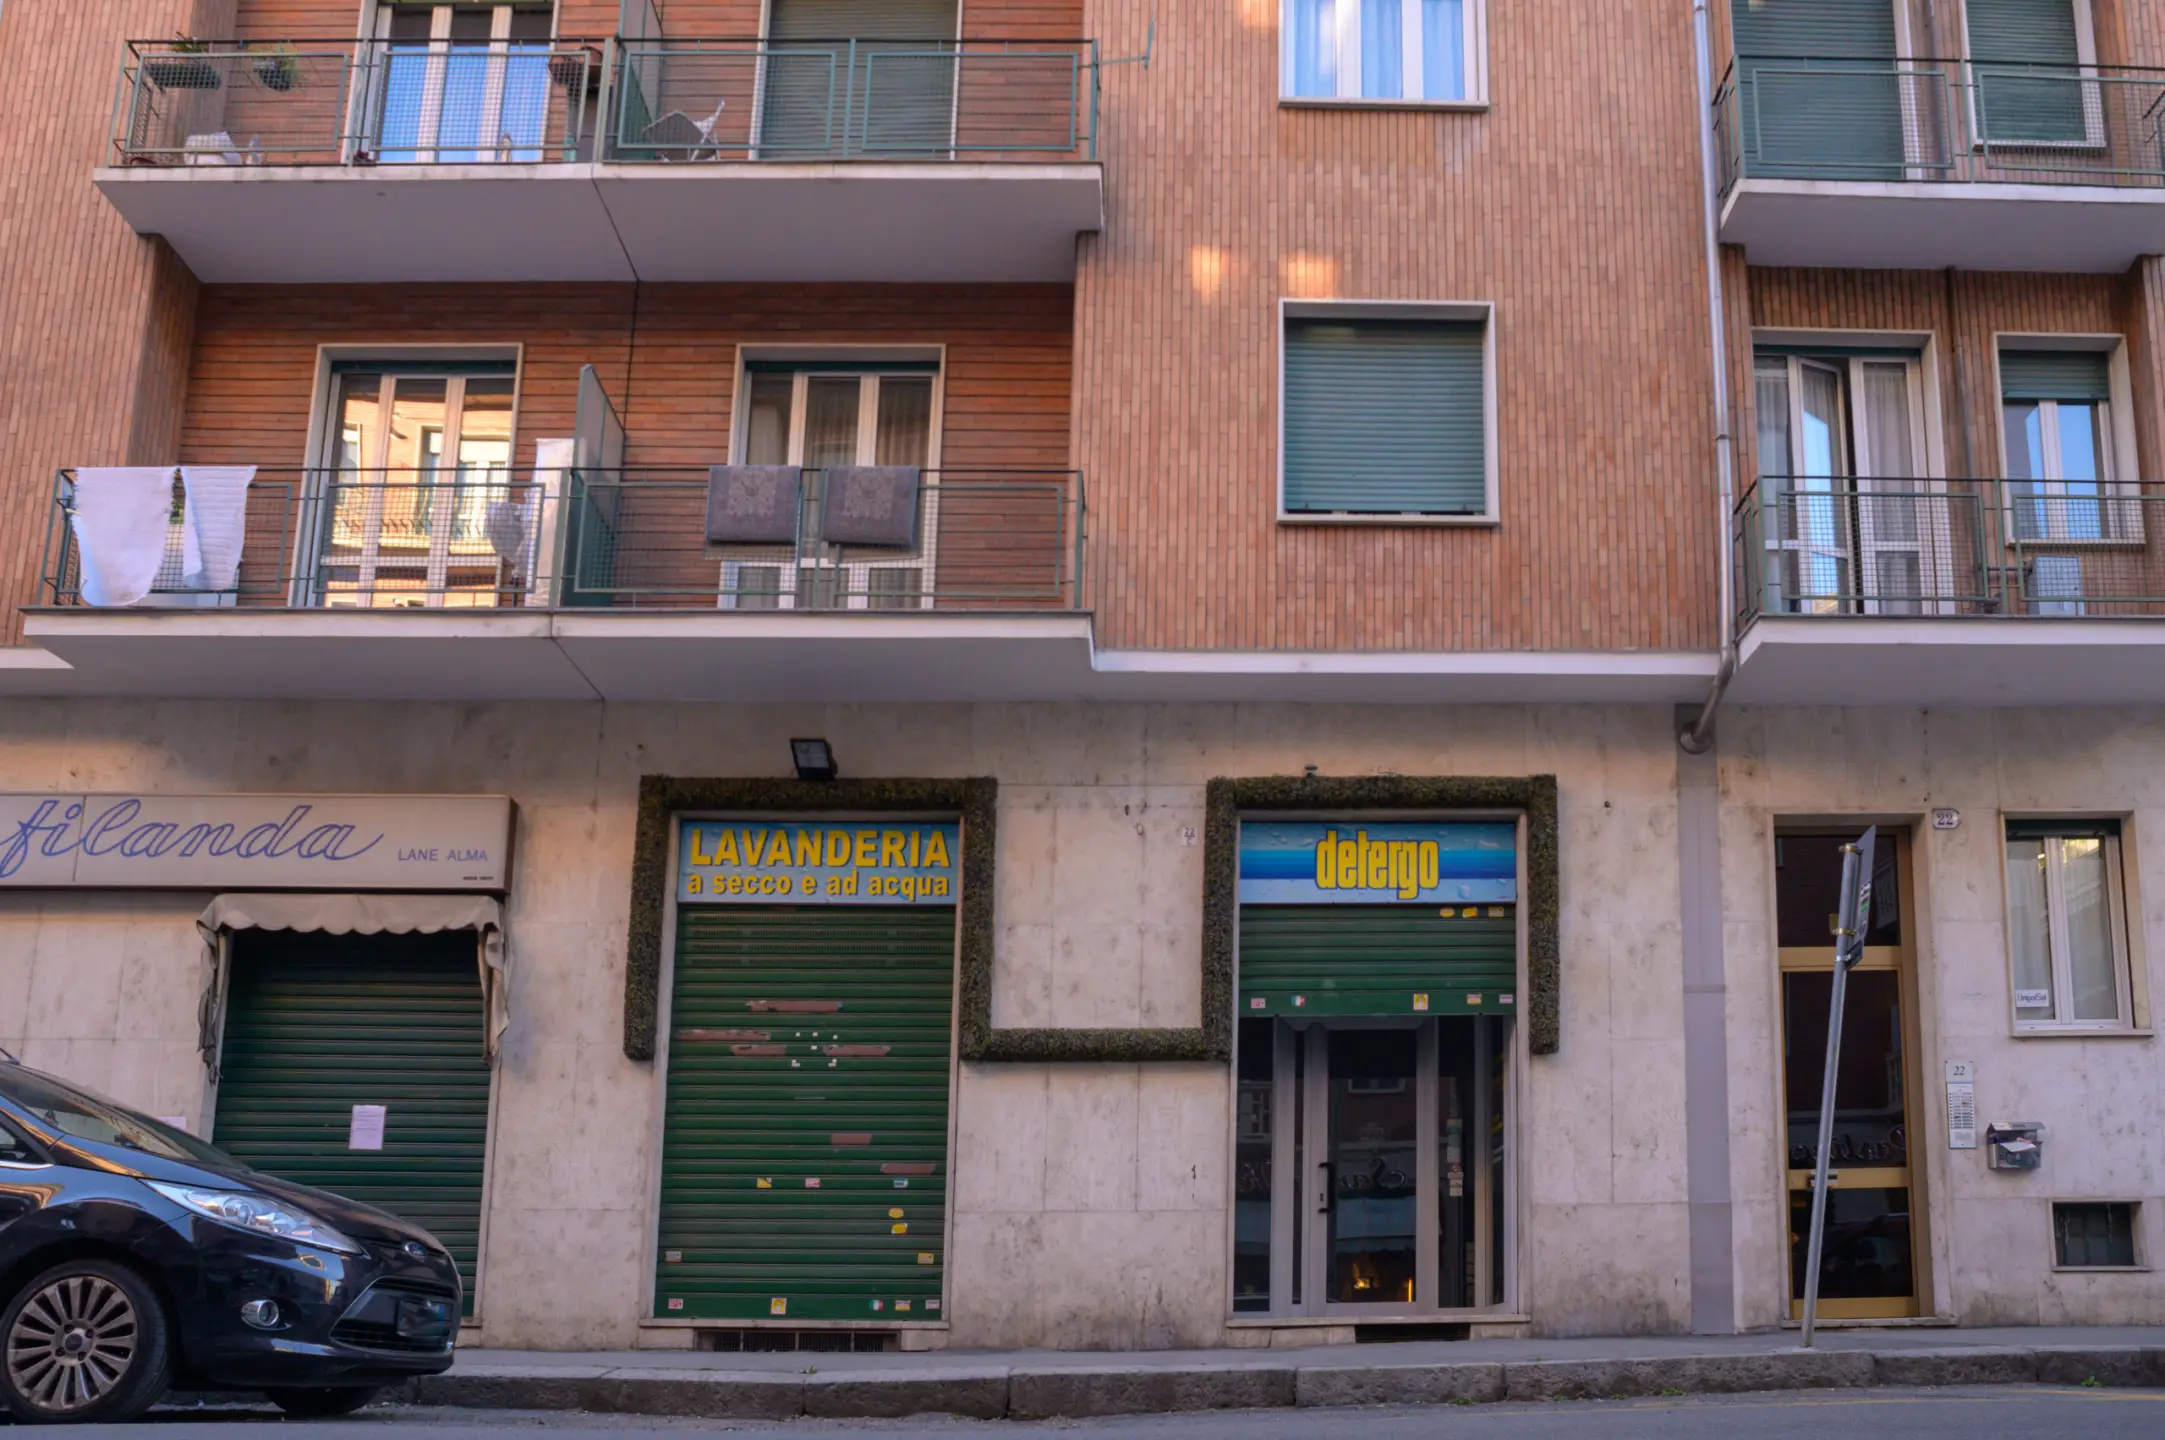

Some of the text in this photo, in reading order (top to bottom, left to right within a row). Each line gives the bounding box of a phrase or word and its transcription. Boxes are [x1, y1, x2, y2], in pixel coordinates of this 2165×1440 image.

[1936, 812, 1953, 826] 22
[0, 799, 384, 878] filanda
[690, 829, 951, 868] LAVANDERIA
[398, 848, 488, 862] LANE ALMA
[1315, 829, 1440, 900] detergo
[687, 870, 950, 902] a secco e ad acqua
[1953, 1065, 1965, 1076] 22
